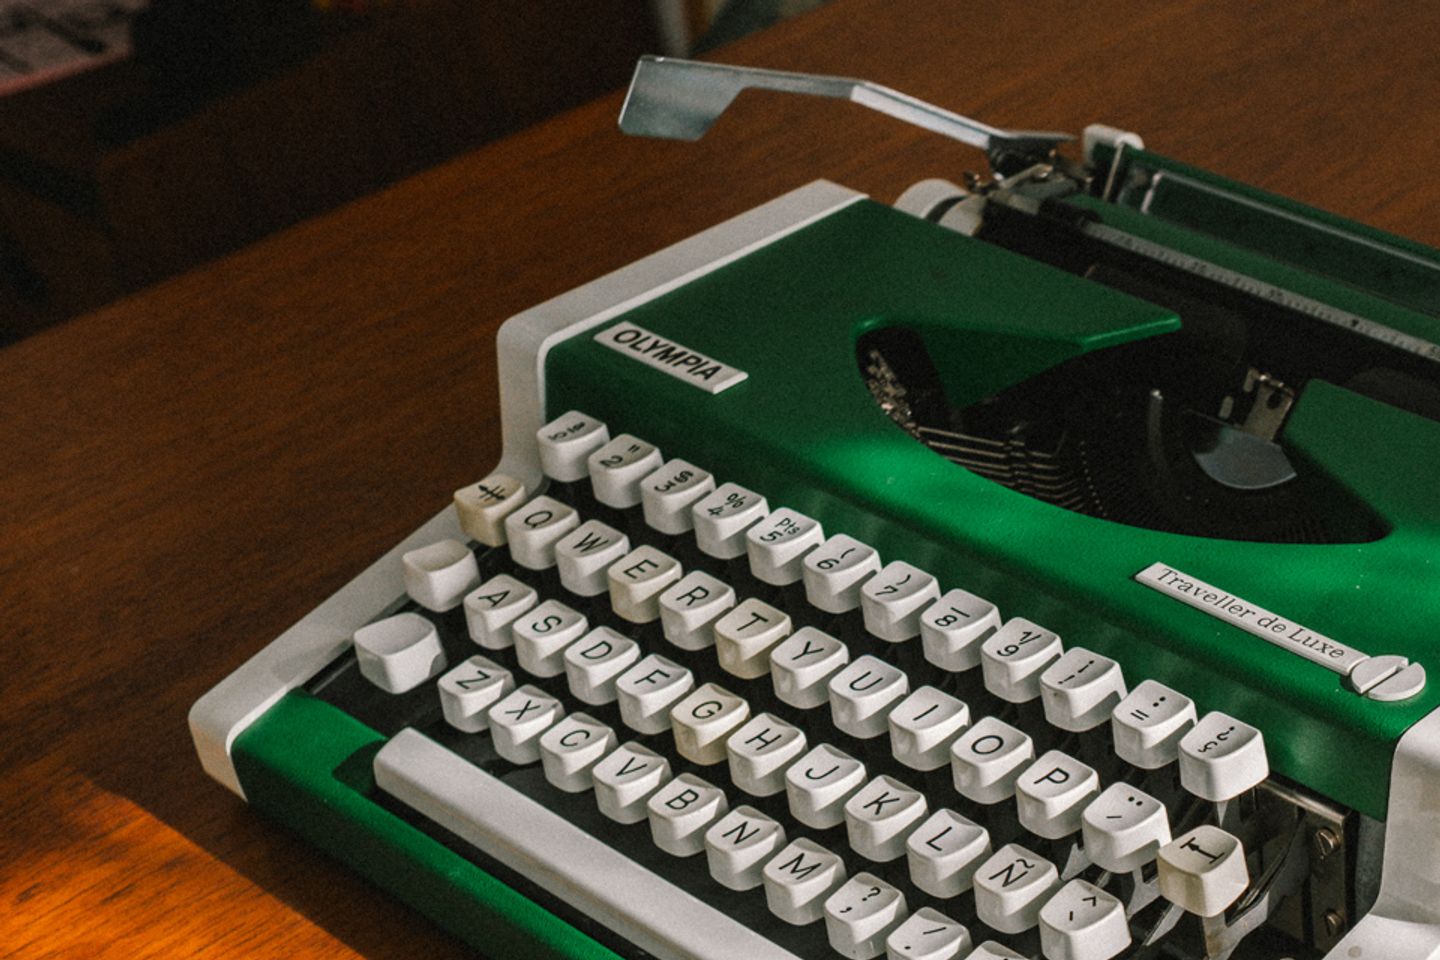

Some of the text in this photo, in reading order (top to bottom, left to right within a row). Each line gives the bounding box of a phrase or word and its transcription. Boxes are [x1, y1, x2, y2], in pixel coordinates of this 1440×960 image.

[613, 329, 722, 380] OLYMPIA
[599, 455, 624, 468] 2
[654, 480, 677, 493] 3
[726, 492, 746, 509] %
[523, 510, 554, 529] Q
[707, 505, 724, 517] 4
[573, 532, 610, 553] W
[759, 530, 784, 542] 5
[623, 558, 660, 580] E
[816, 558, 840, 570] 6
[478, 590, 511, 608] A
[676, 585, 711, 607] R
[875, 585, 899, 596] 7
[737, 611, 770, 632] T
[934, 614, 958, 627] 8
[1157, 567, 1346, 659] Traveller de Luxe
[531, 615, 563, 633] S
[579, 640, 614, 660] D
[792, 640, 825, 661] Y
[996, 644, 1020, 657] 9
[455, 669, 492, 691] Z
[633, 668, 672, 686] F
[849, 670, 884, 692] U
[504, 699, 541, 722] X
[691, 700, 724, 720] G
[912, 703, 940, 722] I
[559, 729, 591, 748] C
[744, 727, 782, 752] H
[970, 734, 1005, 755] O
[615, 756, 649, 777] V
[804, 765, 840, 781] J
[1033, 767, 1071, 785] P
[664, 788, 700, 811] B
[862, 790, 901, 817] K
[721, 821, 761, 846] N
[925, 826, 953, 852] L
[778, 852, 823, 881] M
[989, 858, 1036, 888] Ñ
[861, 886, 882, 902] ?
